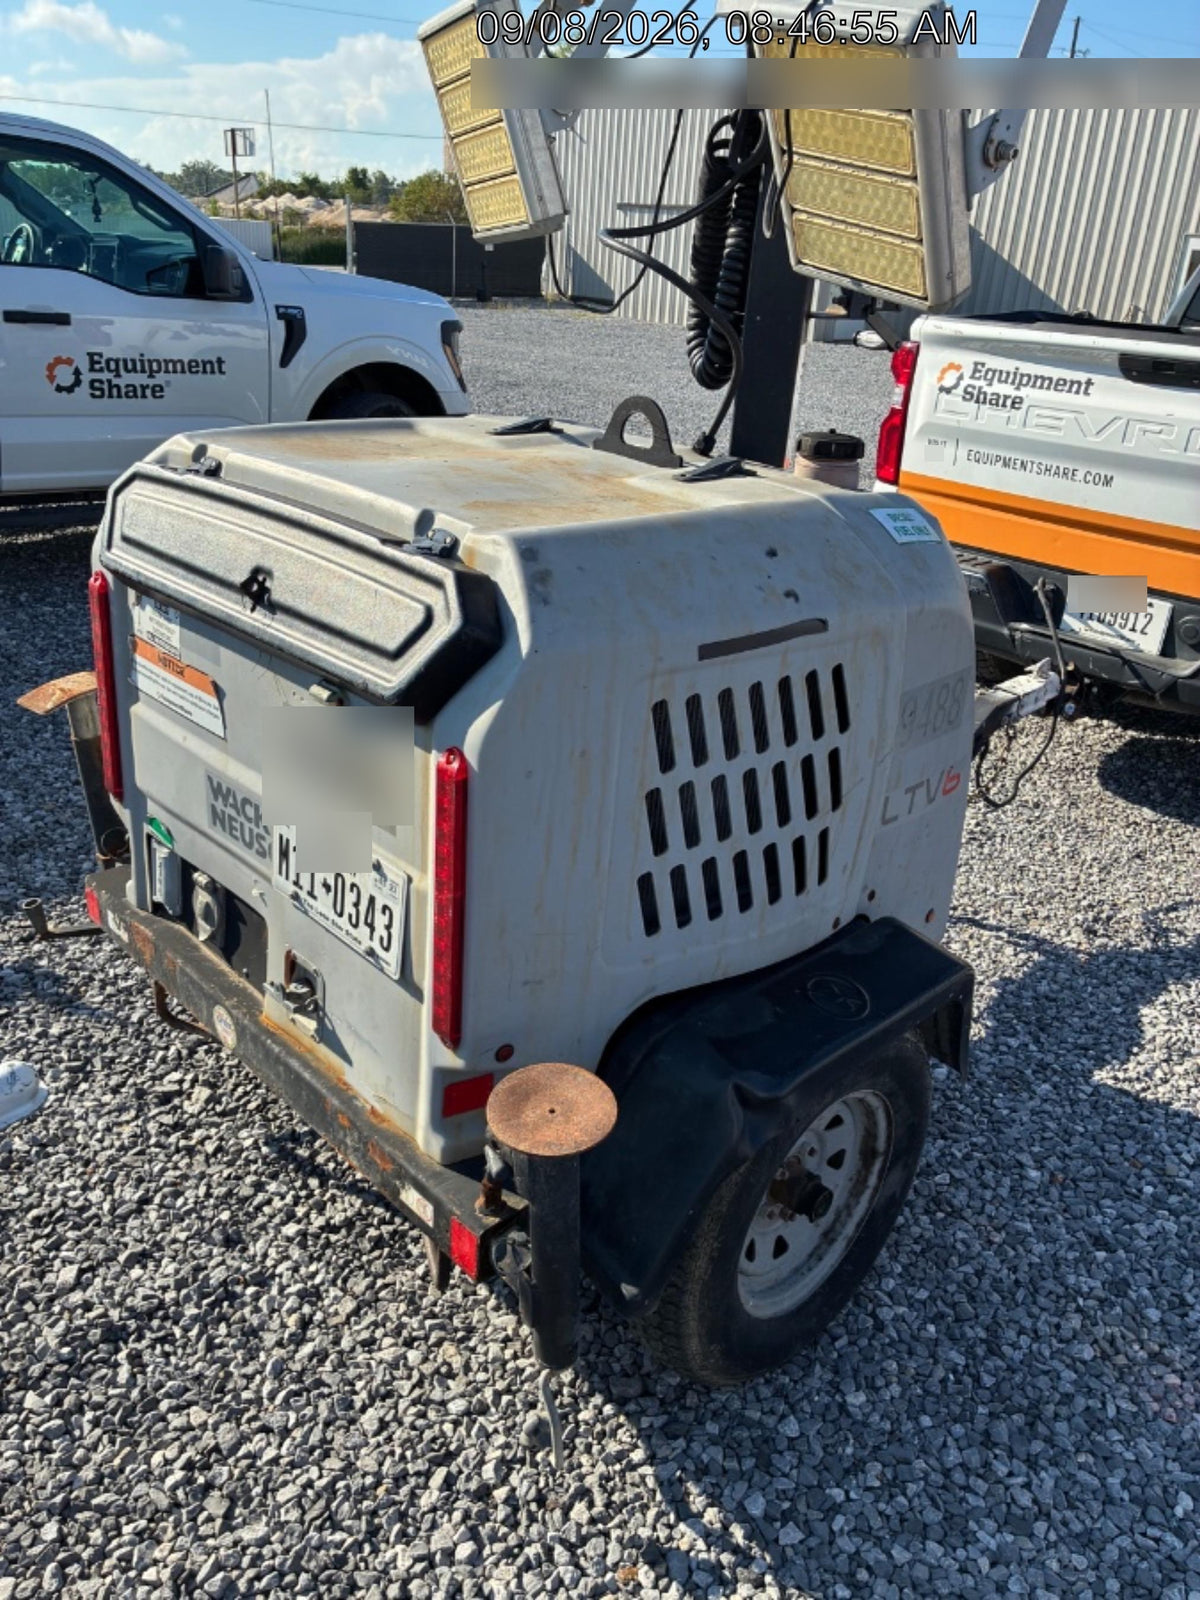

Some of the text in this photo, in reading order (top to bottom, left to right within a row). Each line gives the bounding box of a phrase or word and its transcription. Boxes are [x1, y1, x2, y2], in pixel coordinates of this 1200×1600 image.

[87, 352, 226, 379] Equipment
[969, 361, 1095, 397] Equipment
[89, 379, 165, 399] Share
[962, 385, 1024, 410] Share
[934, 390, 1200, 458] CHEVR
[966, 449, 1114, 488] EQUIPMENTSHARE.COM
[1079, 612, 1149, 635] 9912
